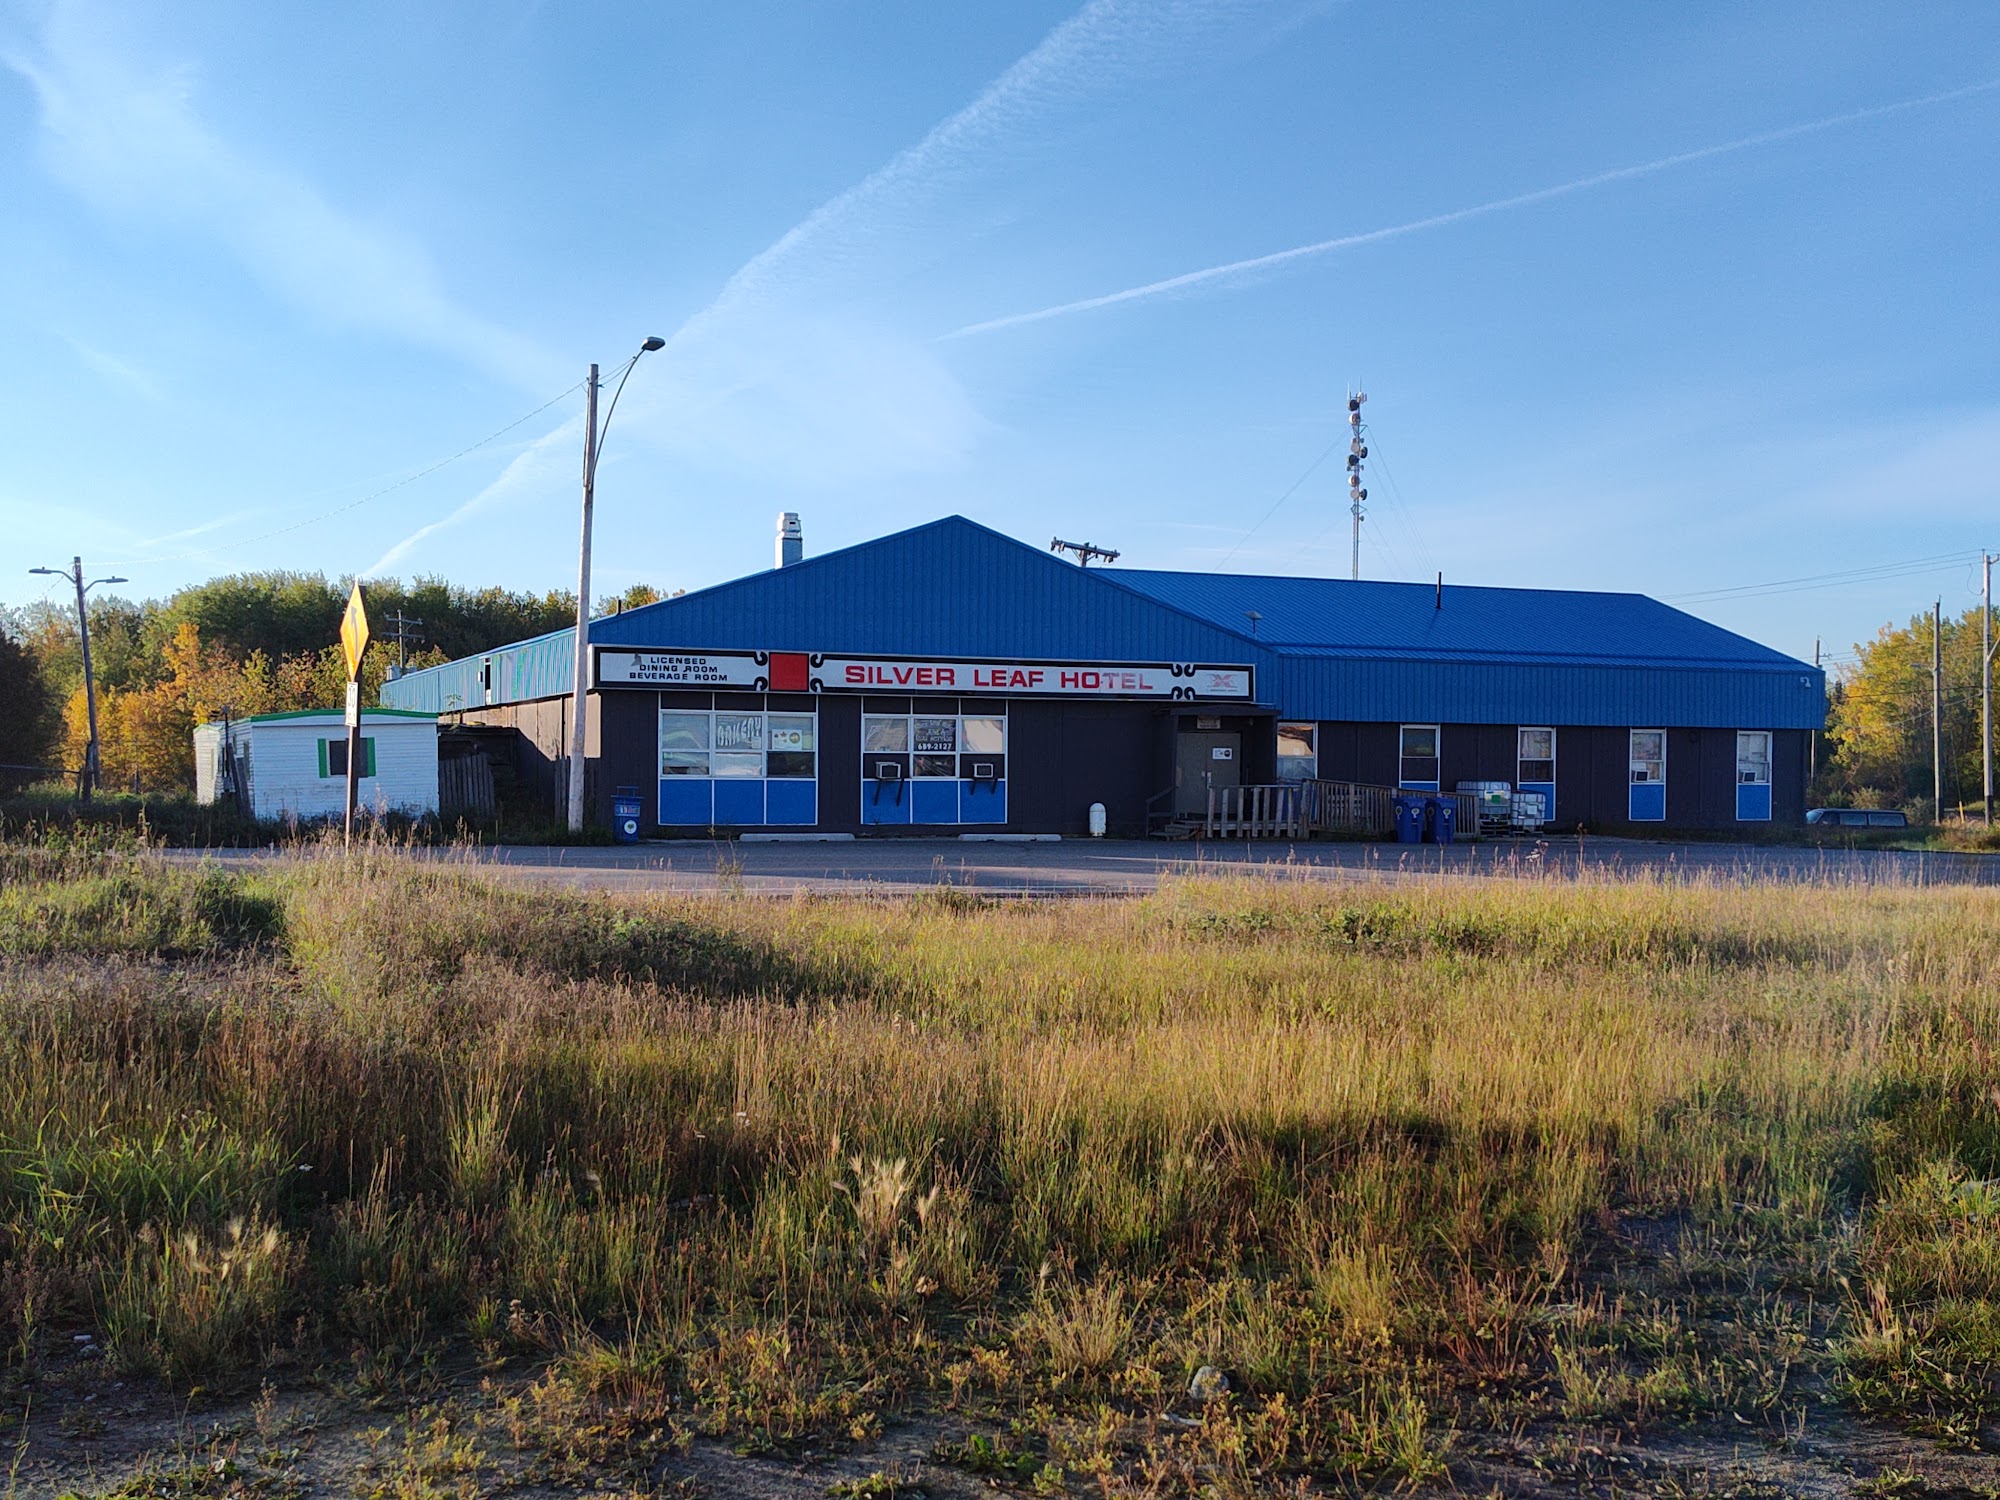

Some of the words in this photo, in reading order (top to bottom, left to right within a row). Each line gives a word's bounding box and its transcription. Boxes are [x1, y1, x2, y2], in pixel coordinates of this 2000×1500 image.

[650, 656, 707, 665] LICENSED
[639, 664, 678, 672] DINING
[629, 672, 688, 681] BEVERAGE
[845, 665, 955, 686] SILVER
[974, 669, 1044, 688] LEAF
[1060, 671, 1153, 690] HOTEL
